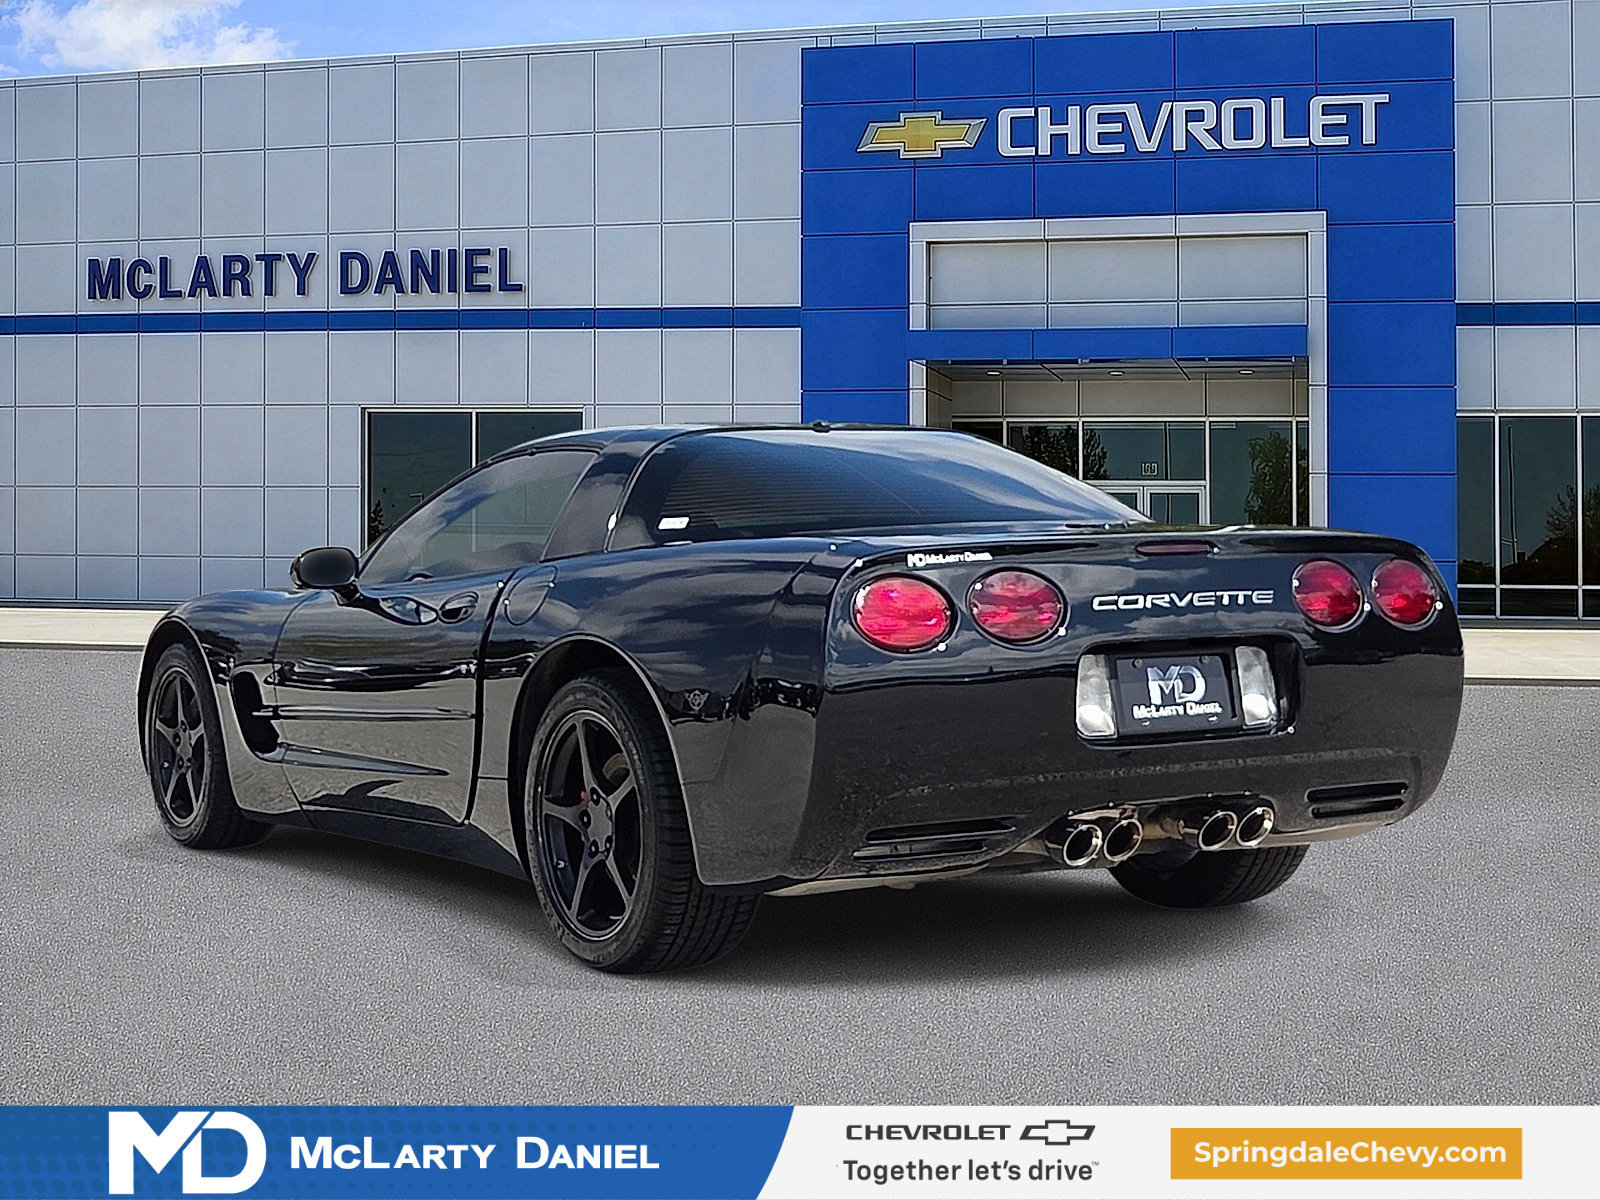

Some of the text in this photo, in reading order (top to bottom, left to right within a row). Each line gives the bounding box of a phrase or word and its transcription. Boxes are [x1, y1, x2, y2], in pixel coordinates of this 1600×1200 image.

[997, 94, 1390, 156] CHEVROLET
[338, 247, 525, 297] DANIEL
[1092, 590, 1274, 611] CORVETTE
[1147, 665, 1206, 705] MD
